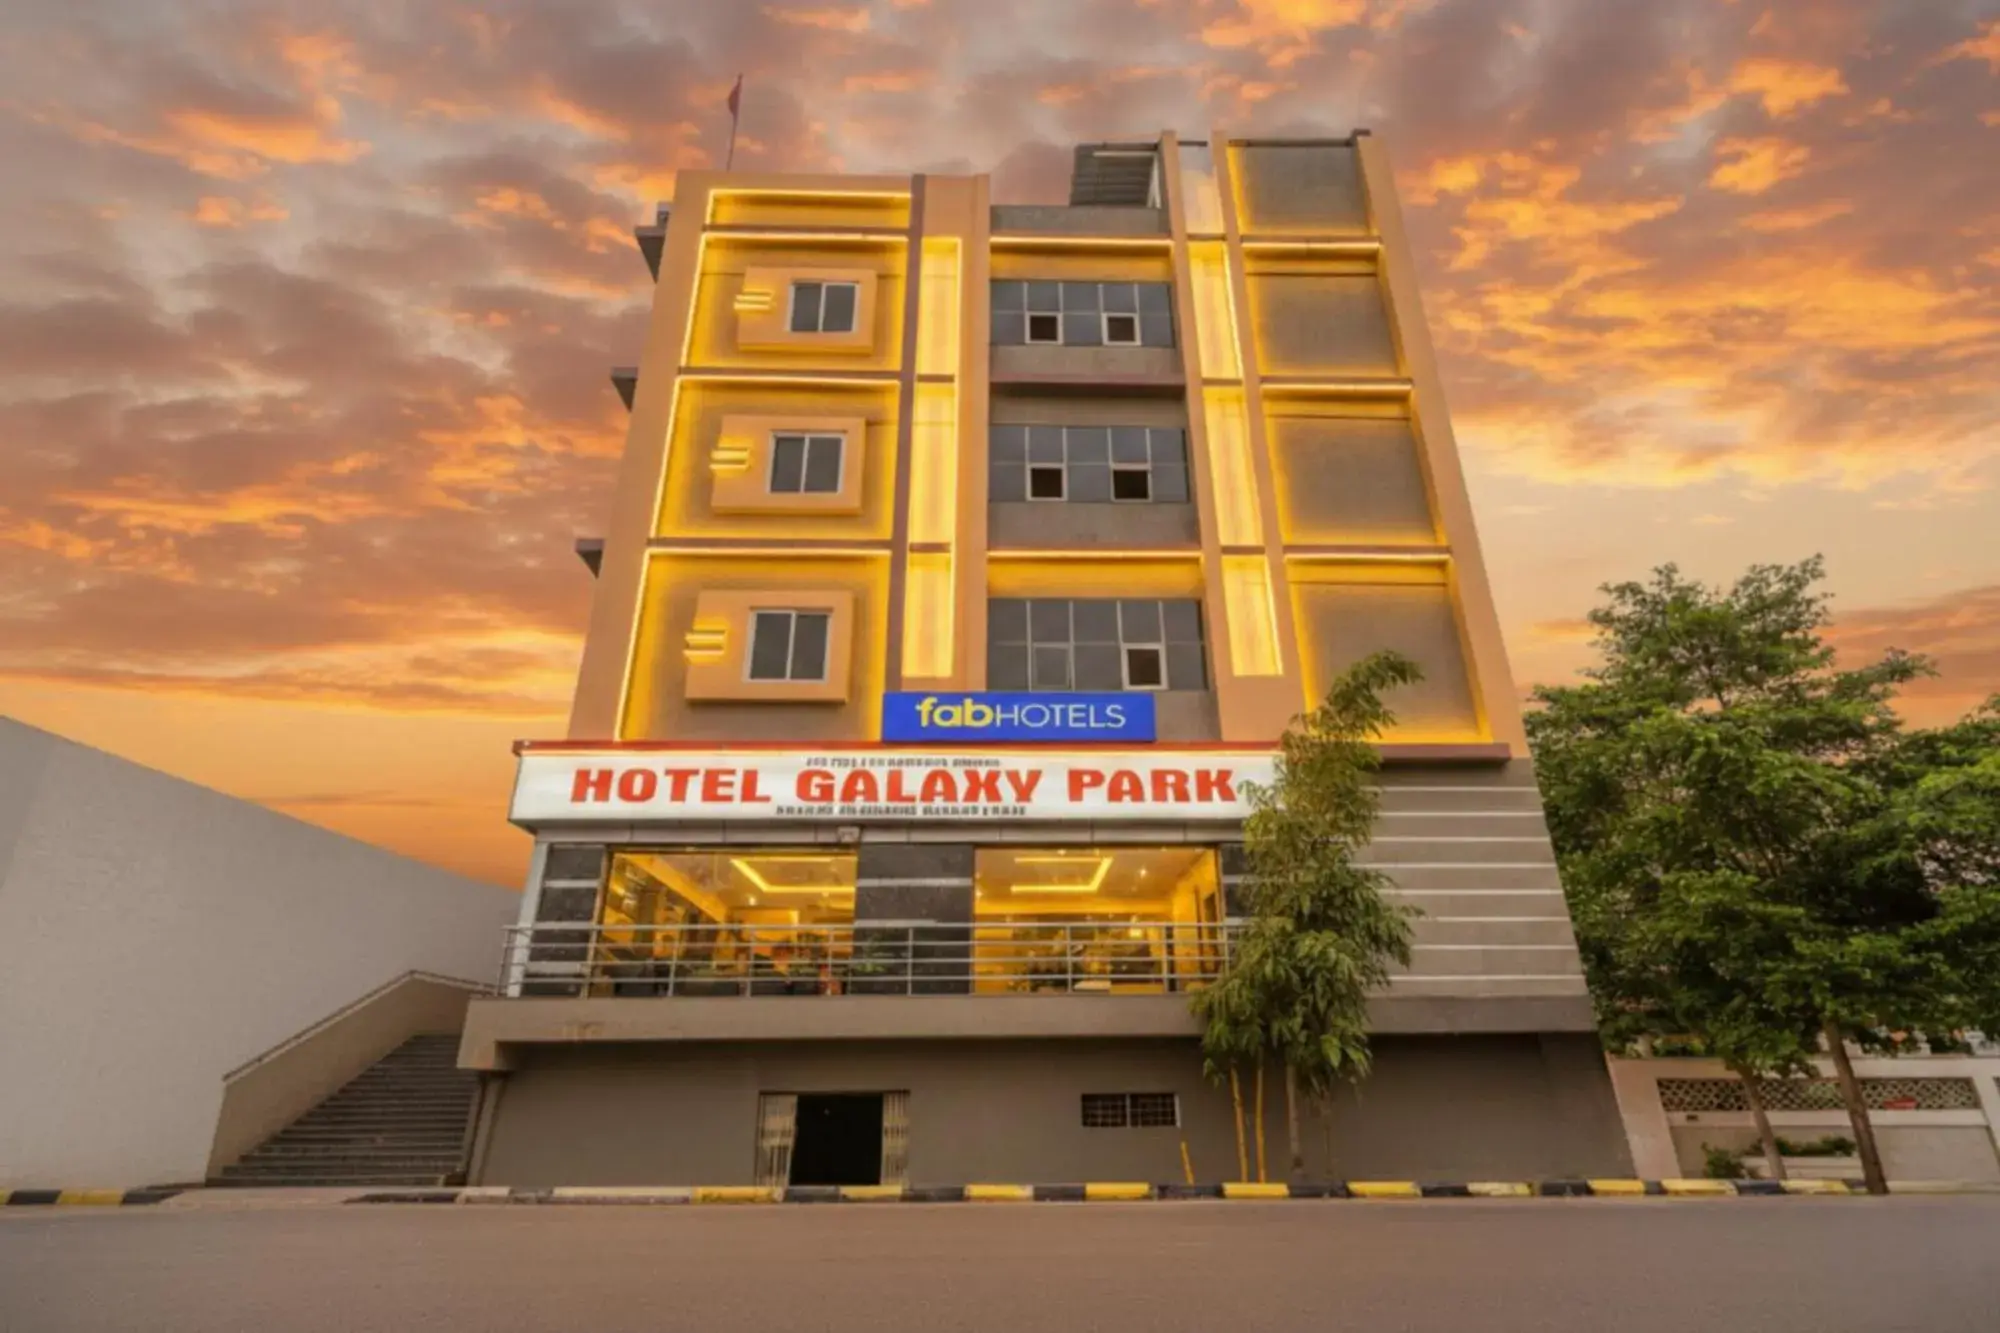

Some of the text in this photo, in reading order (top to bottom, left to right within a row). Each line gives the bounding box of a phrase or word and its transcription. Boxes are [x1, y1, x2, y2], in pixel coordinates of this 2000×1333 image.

[915, 697, 1126, 728] fabHOTELS
[571, 768, 1237, 803] HOTEL GALAXY PARK
